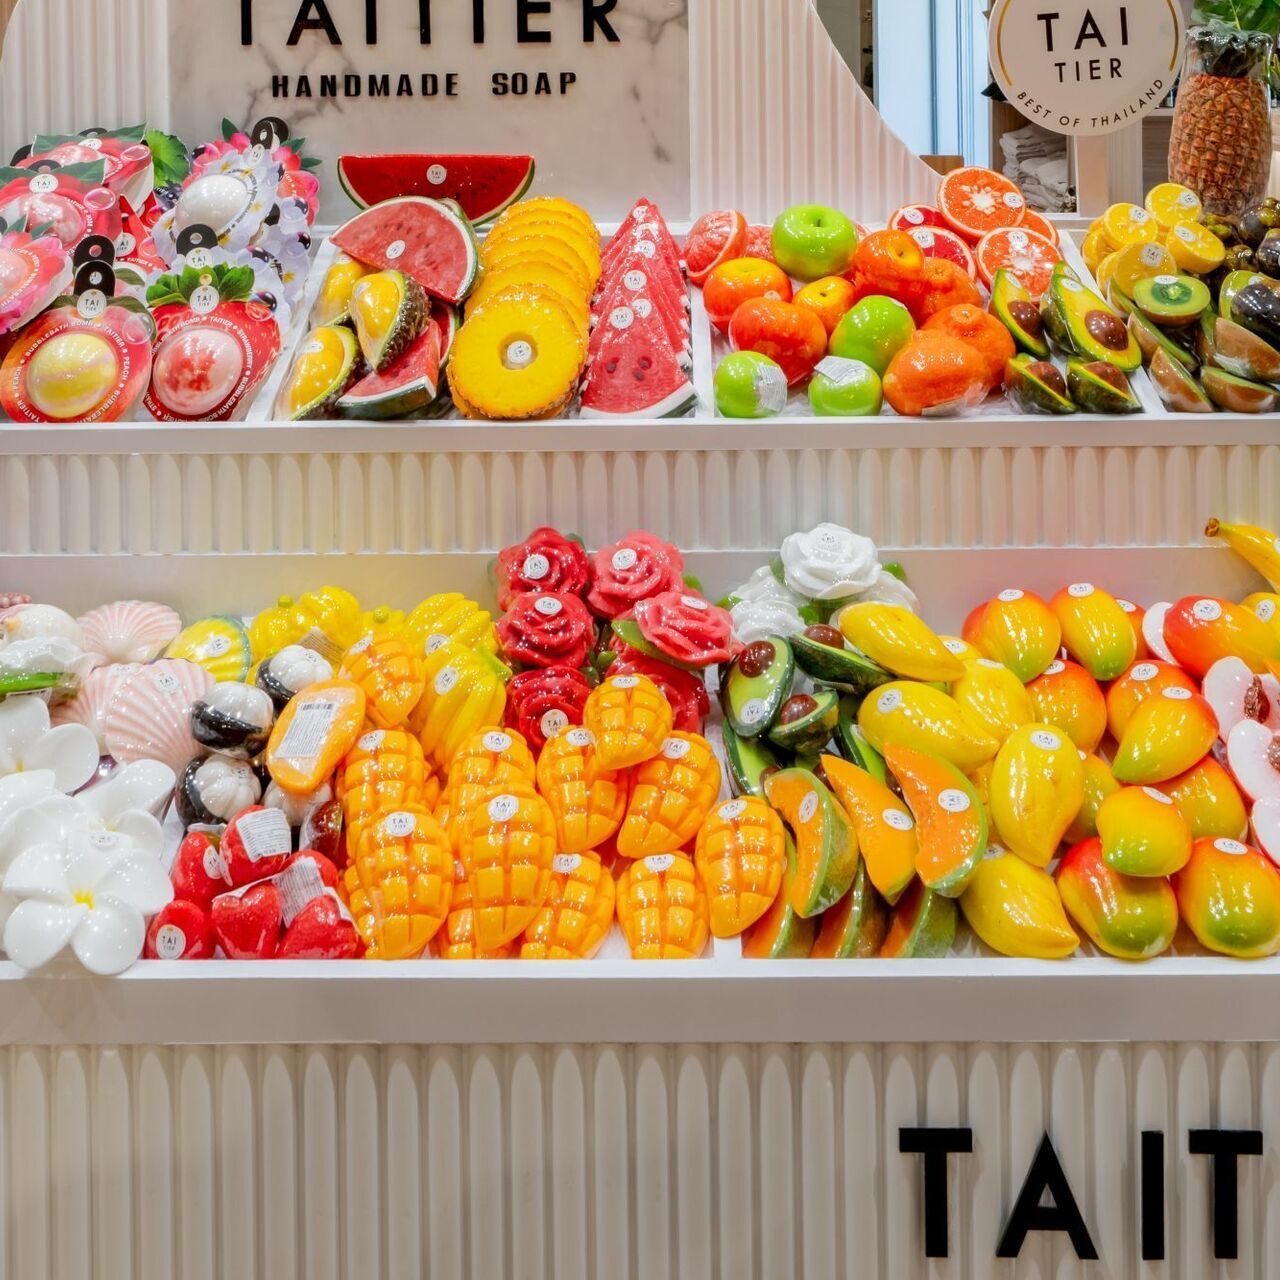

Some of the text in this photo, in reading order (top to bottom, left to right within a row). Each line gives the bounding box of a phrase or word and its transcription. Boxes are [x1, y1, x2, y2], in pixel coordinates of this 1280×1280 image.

[1036, 6, 1128, 52] TAI
[1054, 57, 1123, 83] TIER
[271, 71, 577, 98] HANDMADE SOAP
[1017, 79, 1164, 128] BEST OF THAILAND
[25, 323, 69, 357] BUBBLEBATH
[104, 326, 125, 347] TAITIER
[122, 356, 130, 384] PEACH
[220, 377, 248, 416] BUBBLEBATH
[16, 400, 40, 423] TAITIER
[162, 936, 176, 945] TAI
